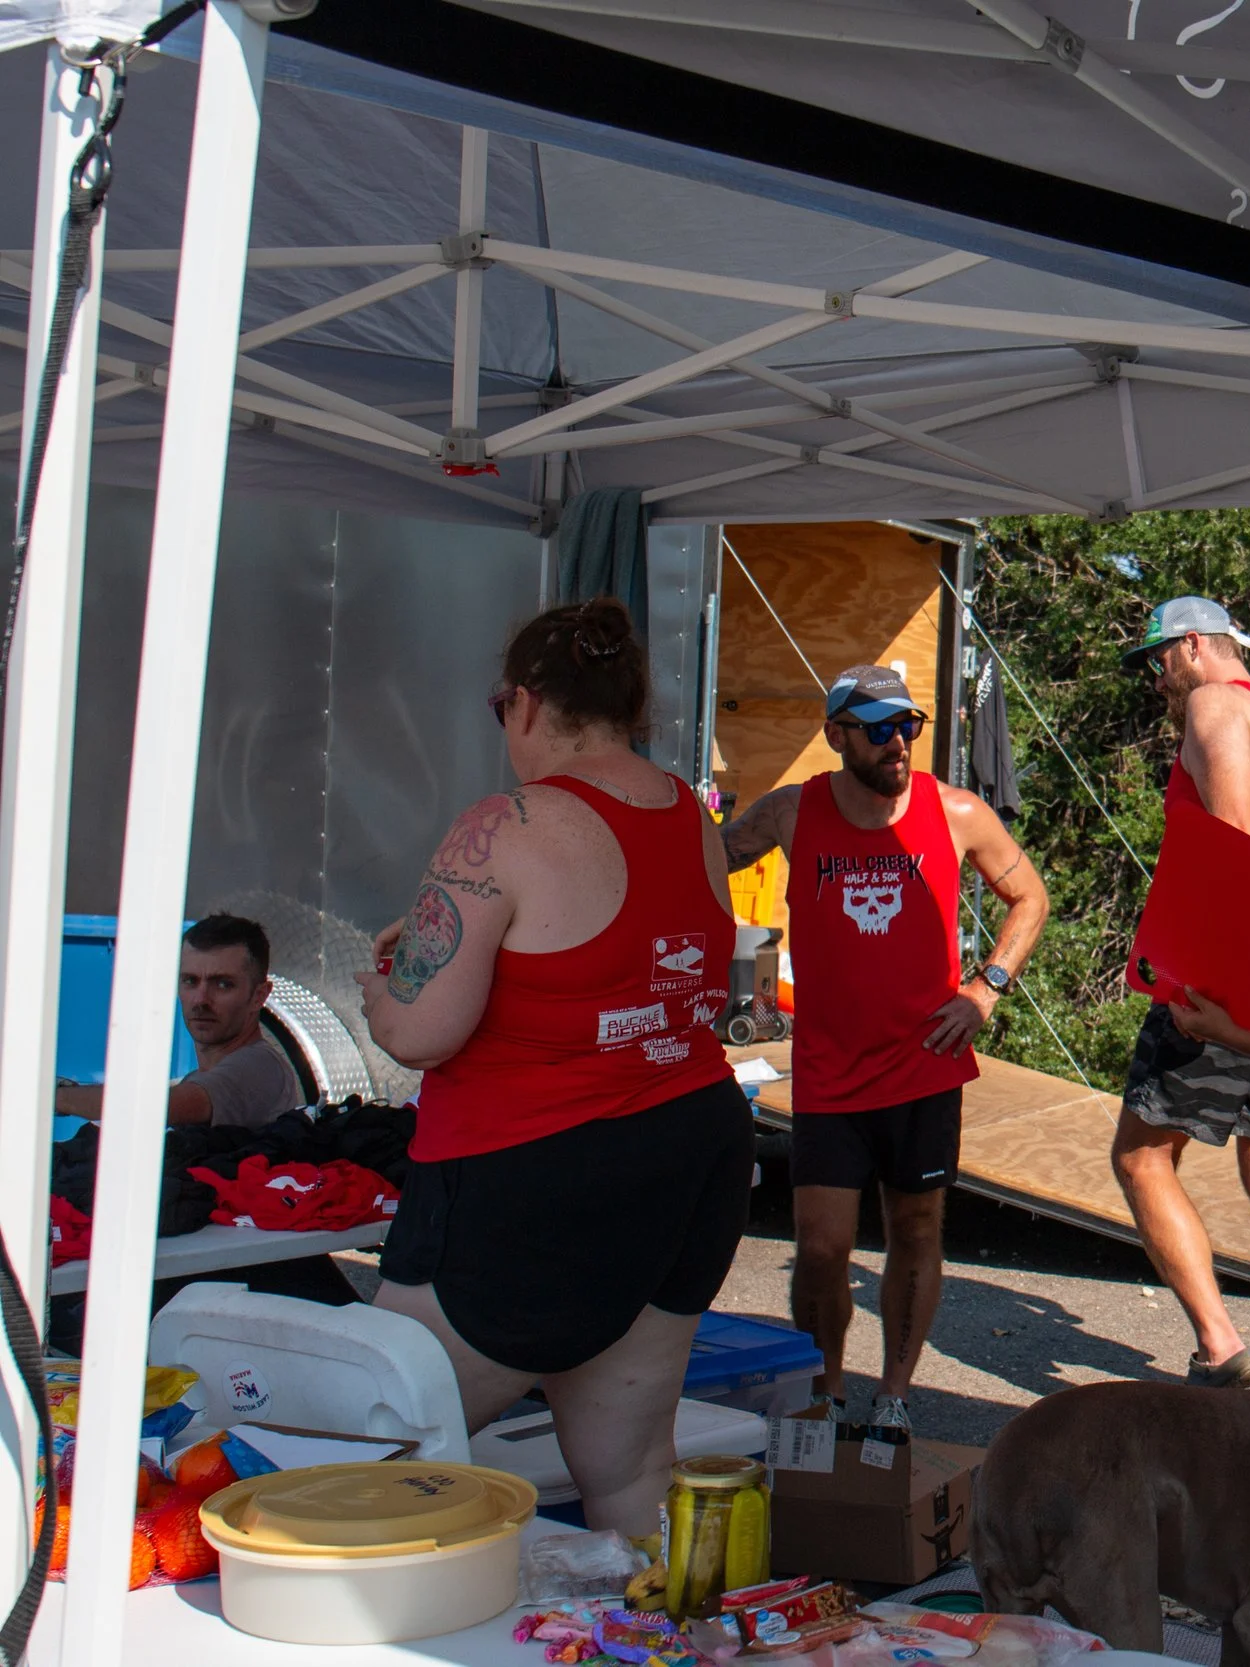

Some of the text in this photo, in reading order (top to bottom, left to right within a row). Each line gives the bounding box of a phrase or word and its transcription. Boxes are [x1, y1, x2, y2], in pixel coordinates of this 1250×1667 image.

[817, 853, 931, 901] HELL CREEK
[844, 872, 900, 884] HALF & 50K
[650, 977, 703, 992] ULTRAVERSE
[683, 992, 704, 1008] LAKE
[608, 1009, 660, 1030] BUCKLE
